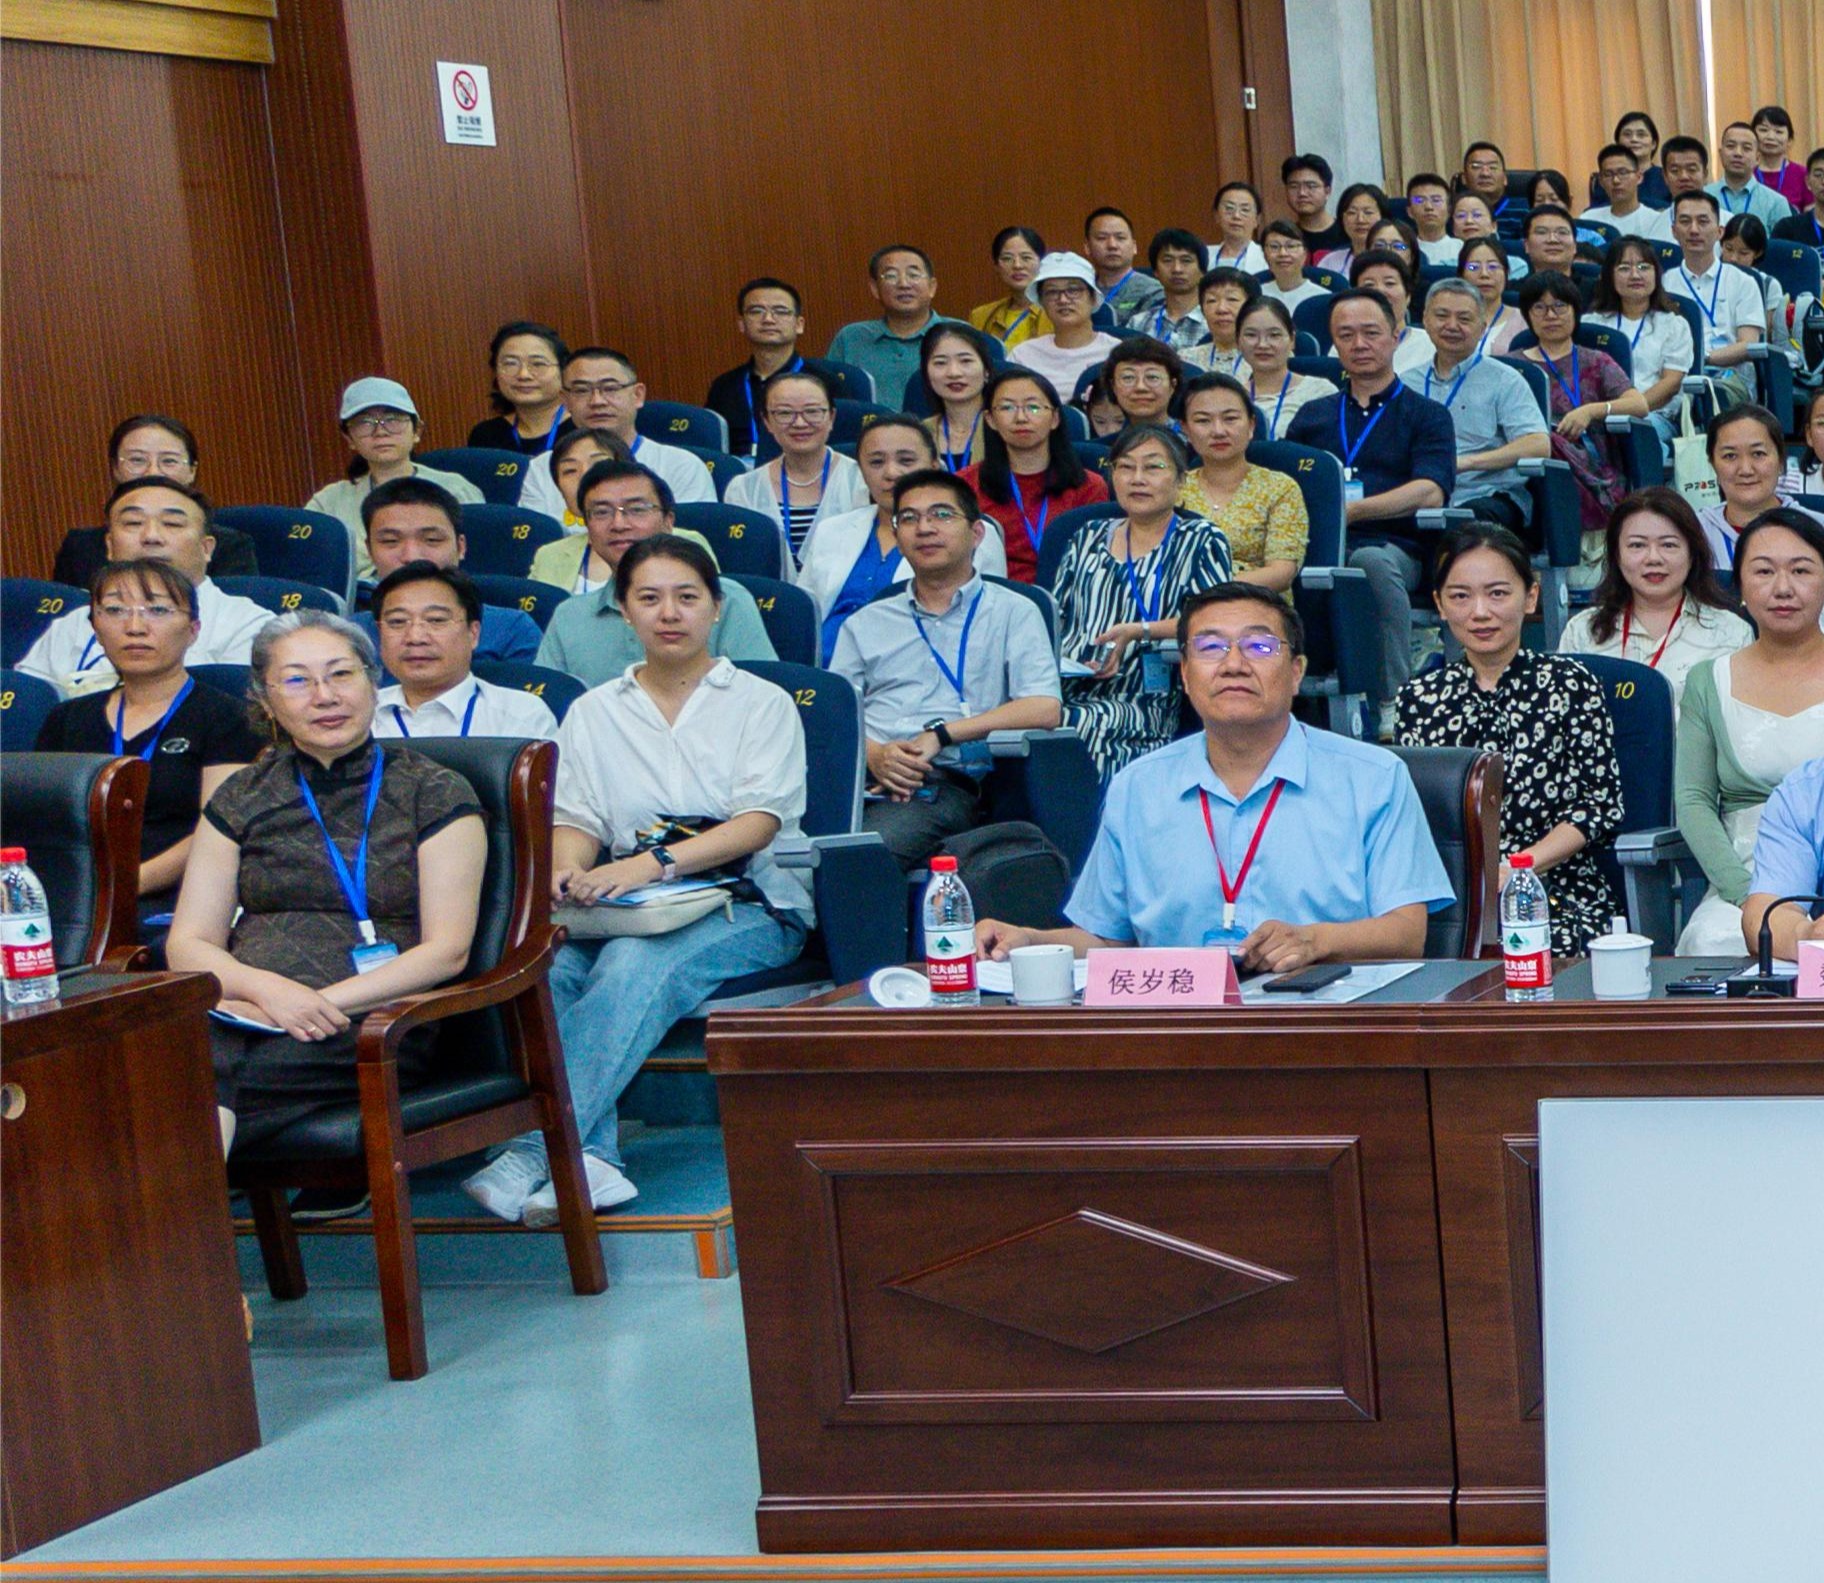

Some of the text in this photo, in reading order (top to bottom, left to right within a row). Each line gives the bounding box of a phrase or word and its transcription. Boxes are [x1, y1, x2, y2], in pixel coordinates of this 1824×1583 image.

[668, 418, 690, 432] 20
[496, 463, 518, 476] 20
[1297, 458, 1315, 472] 12
[288, 523, 312, 539] 20
[512, 524, 530, 540] 18
[729, 524, 745, 538] 16
[37, 597, 63, 614] 20
[282, 593, 301, 610] 18
[519, 596, 536, 611] 16
[757, 597, 775, 611] 14
[795, 689, 816, 706] 12
[1614, 682, 1635, 700] 10
[0, 691, 15, 709] 8
[1107, 967, 1196, 995] 侯岁稳
